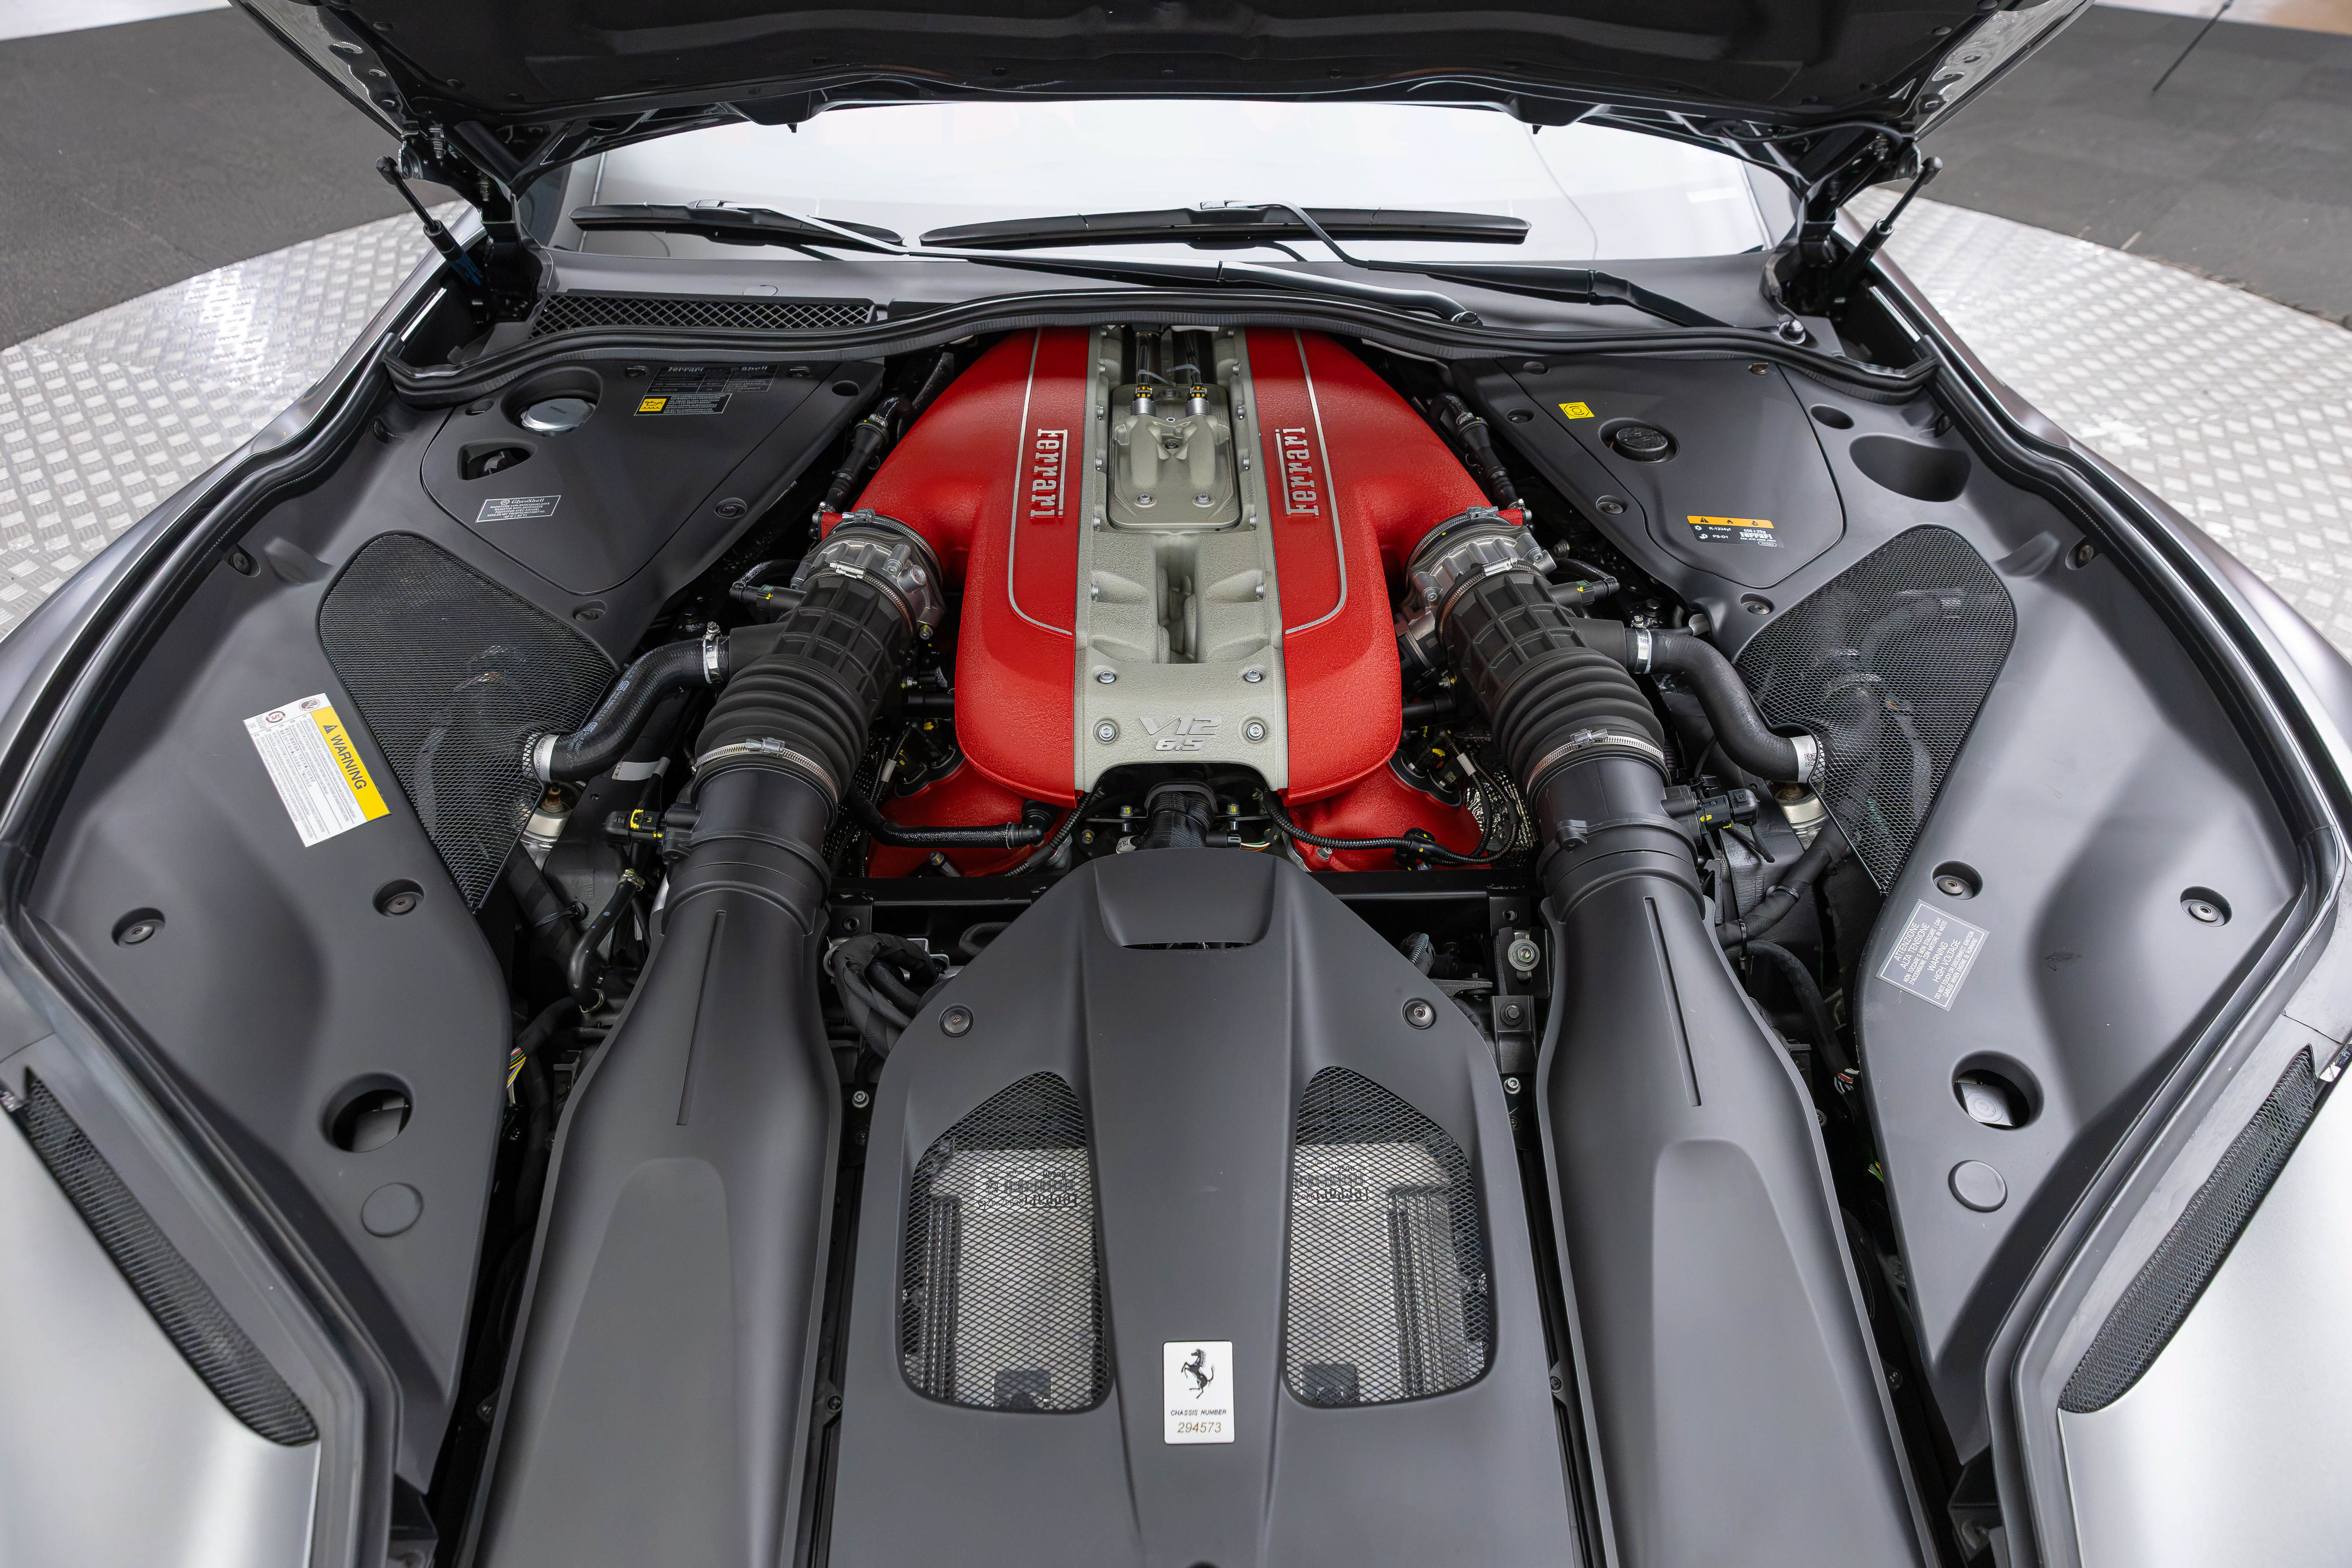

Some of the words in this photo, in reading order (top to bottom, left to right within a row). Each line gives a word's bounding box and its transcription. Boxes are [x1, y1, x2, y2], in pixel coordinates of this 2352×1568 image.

[1030, 428, 1068, 517] Ferrari
[1274, 427, 1319, 516] Ferrari
[331, 326, 367, 790] WARNING
[1139, 717, 1222, 735] V12
[1155, 738, 1204, 751] 6.5
[1893, 922, 1920, 962] ATTENZIONE
[1899, 953, 1913, 969] ALTA
[1907, 922, 1930, 954] TENSIONE
[1902, 973, 1911, 982] NON
[1907, 956, 1920, 973] TOCCARE
[1918, 945, 1927, 954] NON
[1923, 927, 1937, 946] STACCARE
[1933, 917, 1942, 926] CAVI
[1909, 958, 1927, 985] D'ACCENSIONE
[1922, 950, 1931, 960] CON
[1927, 935, 1940, 951] MOTORE
[1938, 920, 1948, 932] MOTO
[1927, 940, 1949, 972] WARNING
[1951, 945, 1967, 968] DISCONNECT
[1962, 930, 1975, 947] IGNITION
[1931, 965, 1946, 983] HIGH
[1940, 938, 1961, 966] VOLTAGE
[1941, 972, 1952, 986] TOUCH
[1942, 983, 1954, 998] CABLES
[1950, 971, 1960, 984] WHEN
[1956, 958, 1967, 972] ENGINE
[1965, 937, 1978, 954] RUNNING
[1937, 984, 1946, 993] NOT
[1177, 1421, 1222, 1434] 294573
